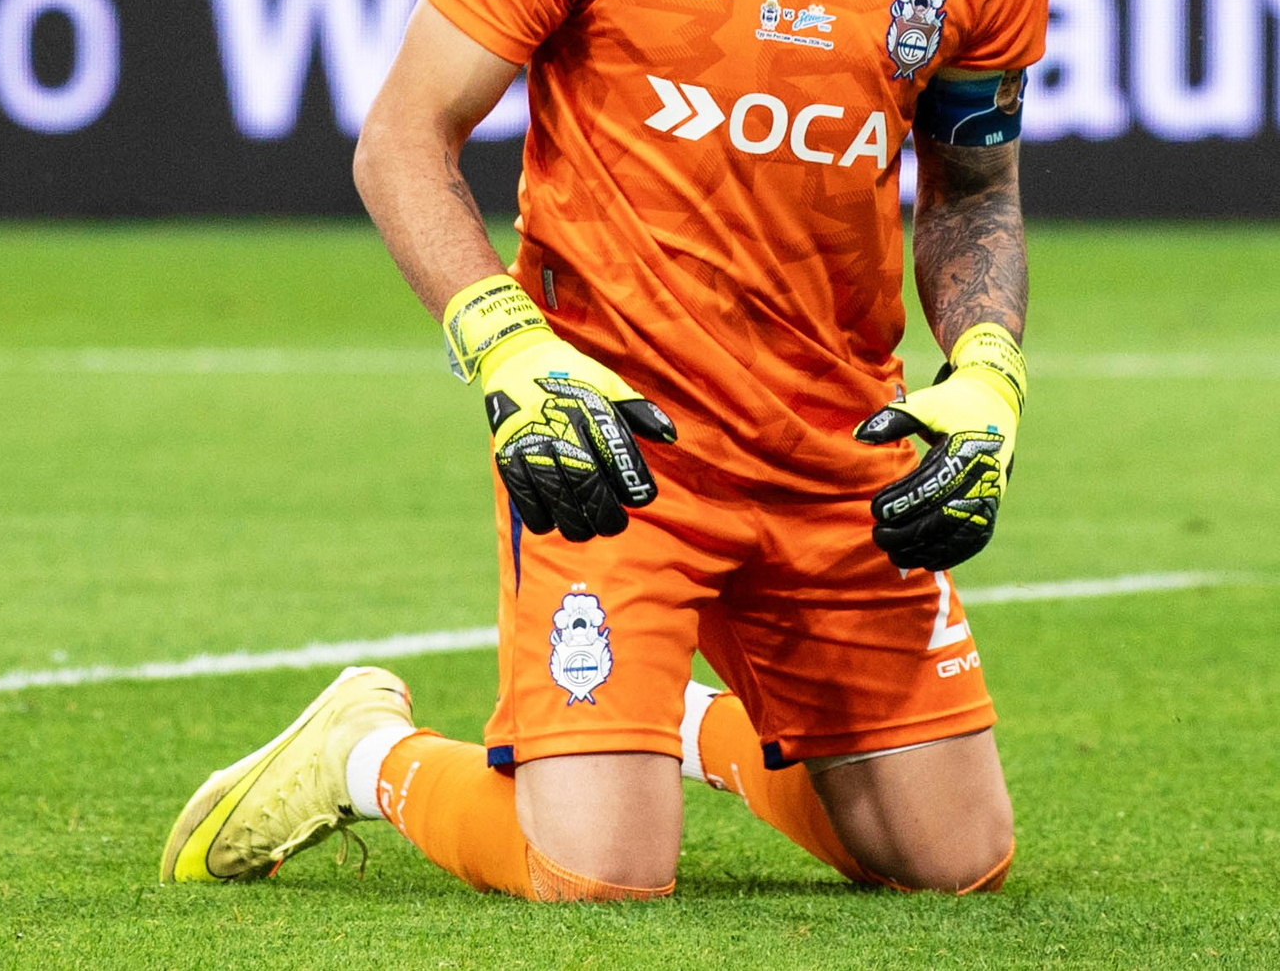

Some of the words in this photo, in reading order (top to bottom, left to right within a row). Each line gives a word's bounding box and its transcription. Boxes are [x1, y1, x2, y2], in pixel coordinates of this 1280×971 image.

[729, 93, 888, 169] OCA
[594, 414, 651, 501] reusch
[882, 455, 963, 519] reusch
